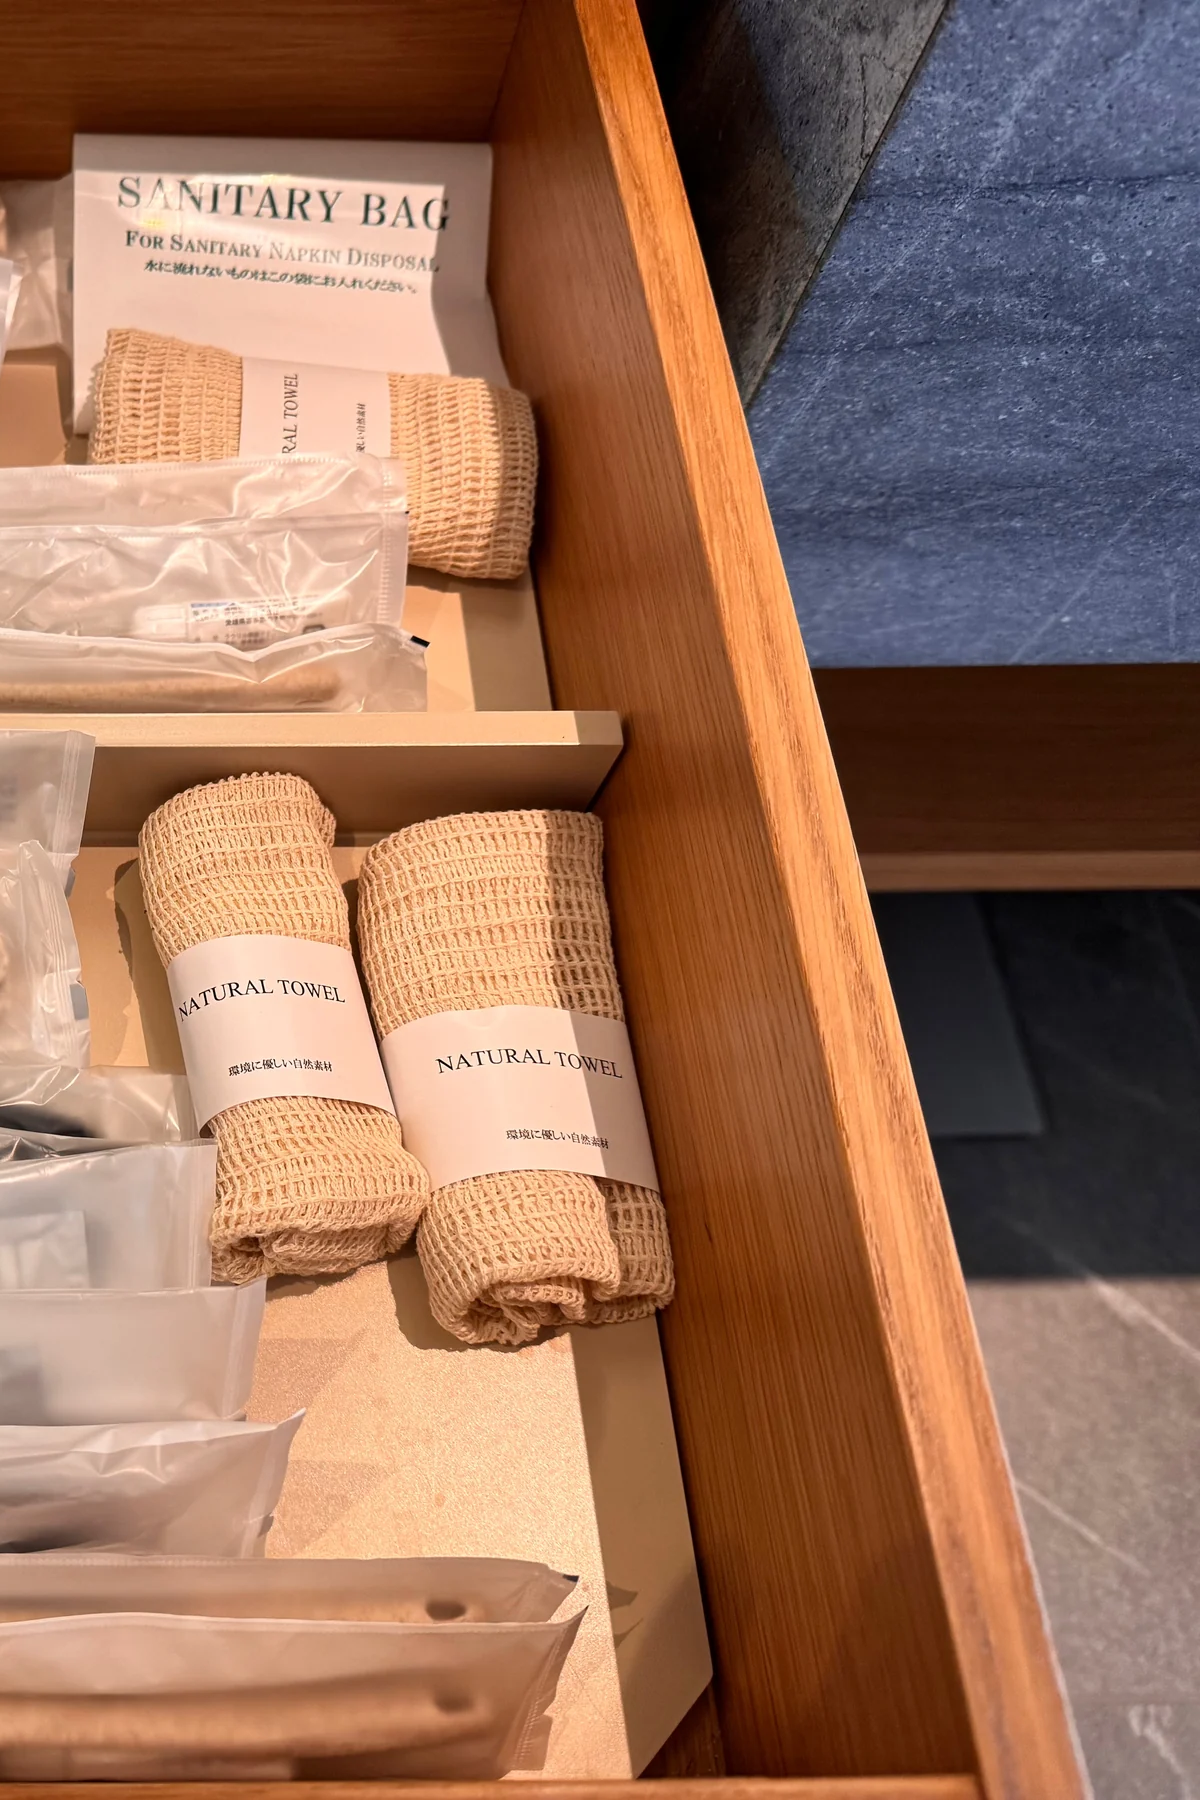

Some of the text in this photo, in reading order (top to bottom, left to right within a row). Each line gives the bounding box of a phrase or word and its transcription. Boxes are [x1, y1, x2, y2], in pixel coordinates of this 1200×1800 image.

[118, 177, 450, 232] SANITARY BAG
[125, 230, 441, 272] FOR SANITARY NAPKIN DISPOSAL
[283, 373, 298, 420] TOWEL
[178, 978, 346, 1023] NATURAL TOWEL
[228, 1058, 333, 1077] 環境に優しい自然素材
[436, 1048, 623, 1080] NATURAL TOWEL
[505, 1128, 609, 1149] 環境に優しい自然素材
